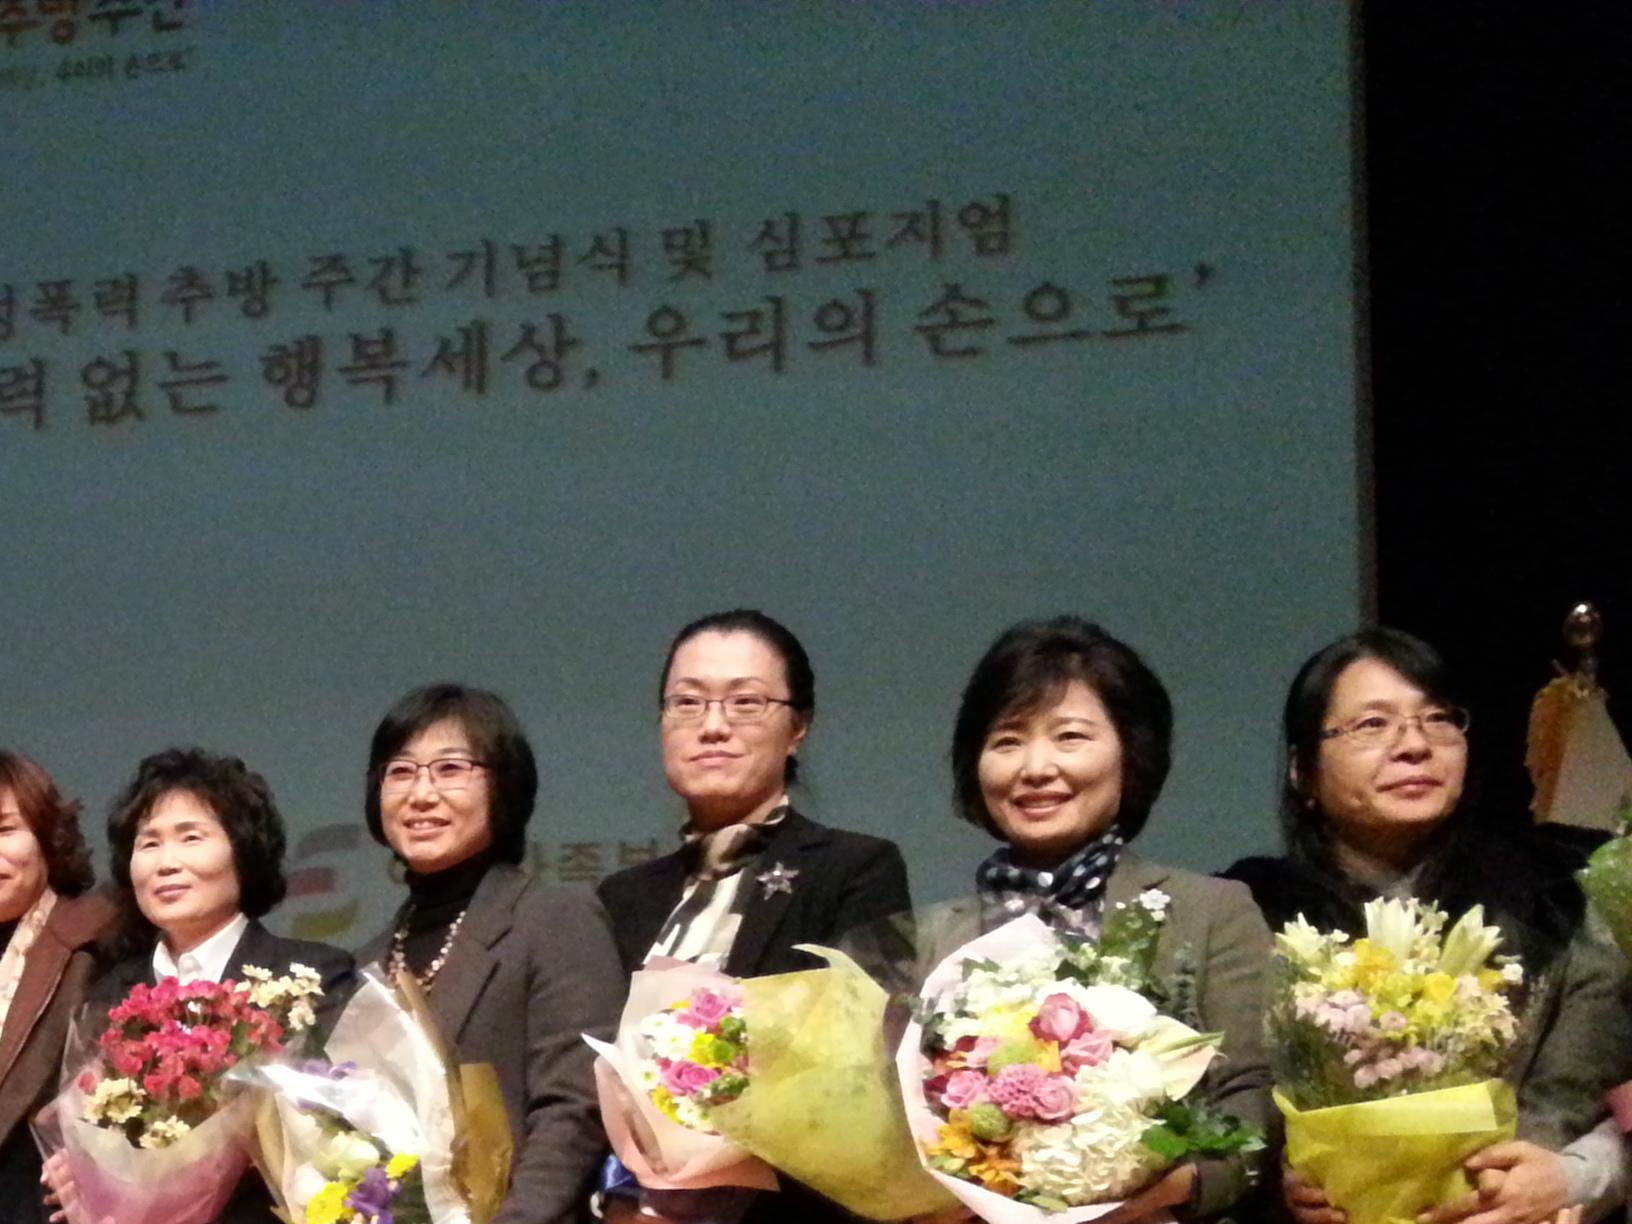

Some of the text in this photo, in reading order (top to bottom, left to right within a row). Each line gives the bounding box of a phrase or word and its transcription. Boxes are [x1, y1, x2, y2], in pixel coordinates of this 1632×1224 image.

[159, 259, 279, 323] 추방
[300, 246, 422, 310] 주간
[446, 226, 632, 299] 기념식
[659, 218, 714, 281] 및
[749, 193, 1014, 273] 심포지엄
[81, 348, 228, 427] 없는
[259, 312, 599, 410] 행복세상,
[626, 286, 878, 381] 우리의
